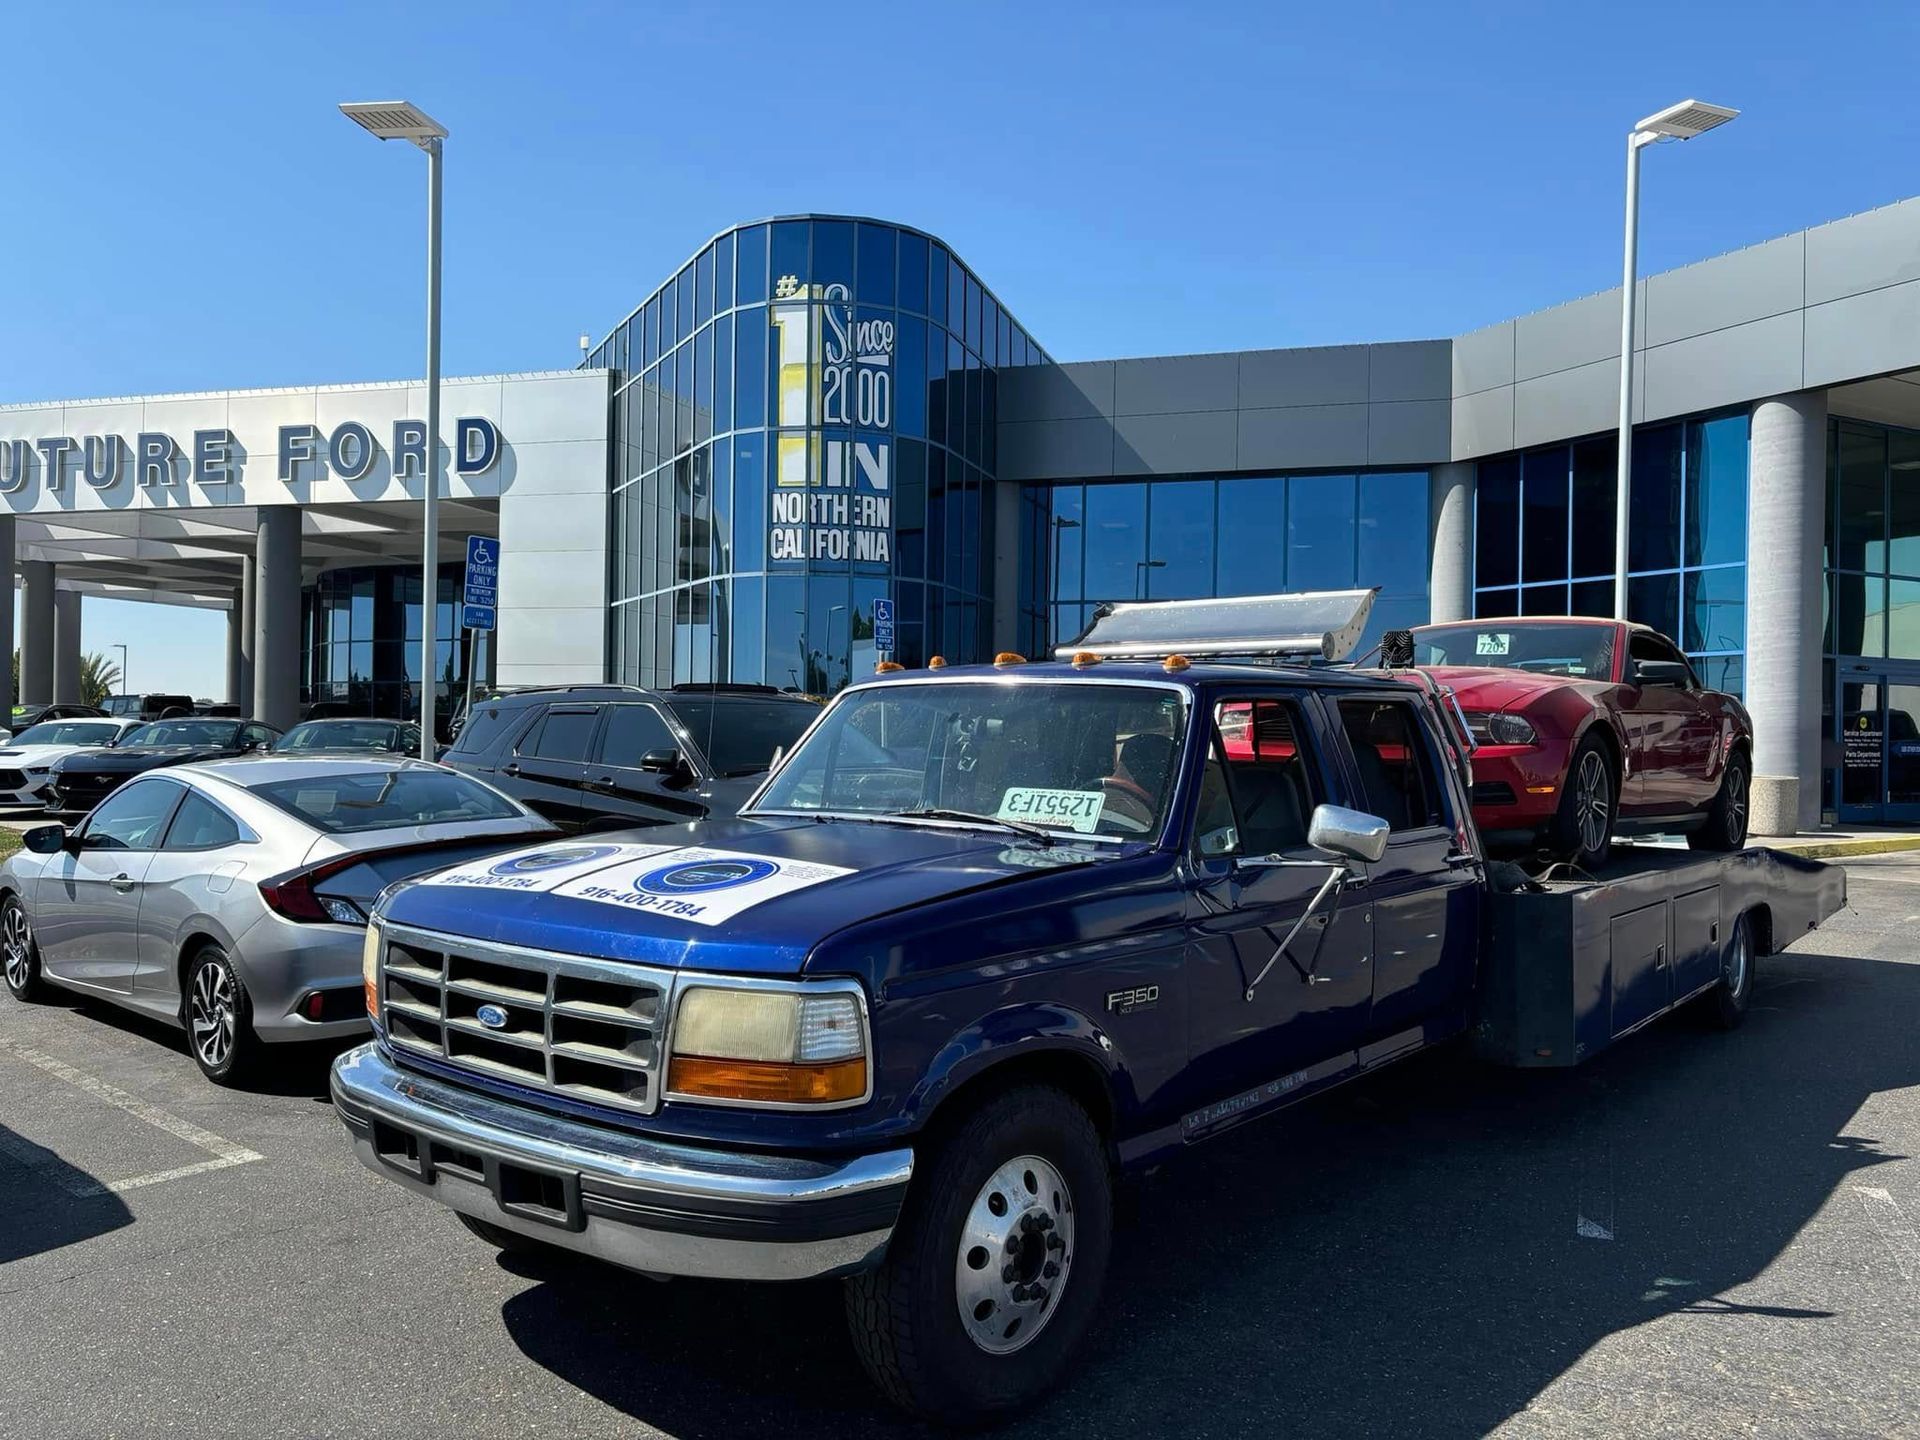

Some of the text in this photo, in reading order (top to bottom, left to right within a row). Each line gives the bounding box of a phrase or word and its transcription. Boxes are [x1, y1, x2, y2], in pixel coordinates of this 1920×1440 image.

[823, 283, 894, 364] Since
[278, 416, 498, 482] FORD
[827, 441, 889, 490] IN
[772, 492, 890, 528] NORTHERN
[770, 528, 890, 562] CALIFORNIA
[468, 563, 497, 577] PARKING
[473, 575, 491, 586] ONLY
[1480, 642, 1506, 653] 7205
[1008, 793, 1098, 817] 12551F3
[577, 886, 707, 917] 916-400-1784
[1108, 985, 1159, 1010] F350
